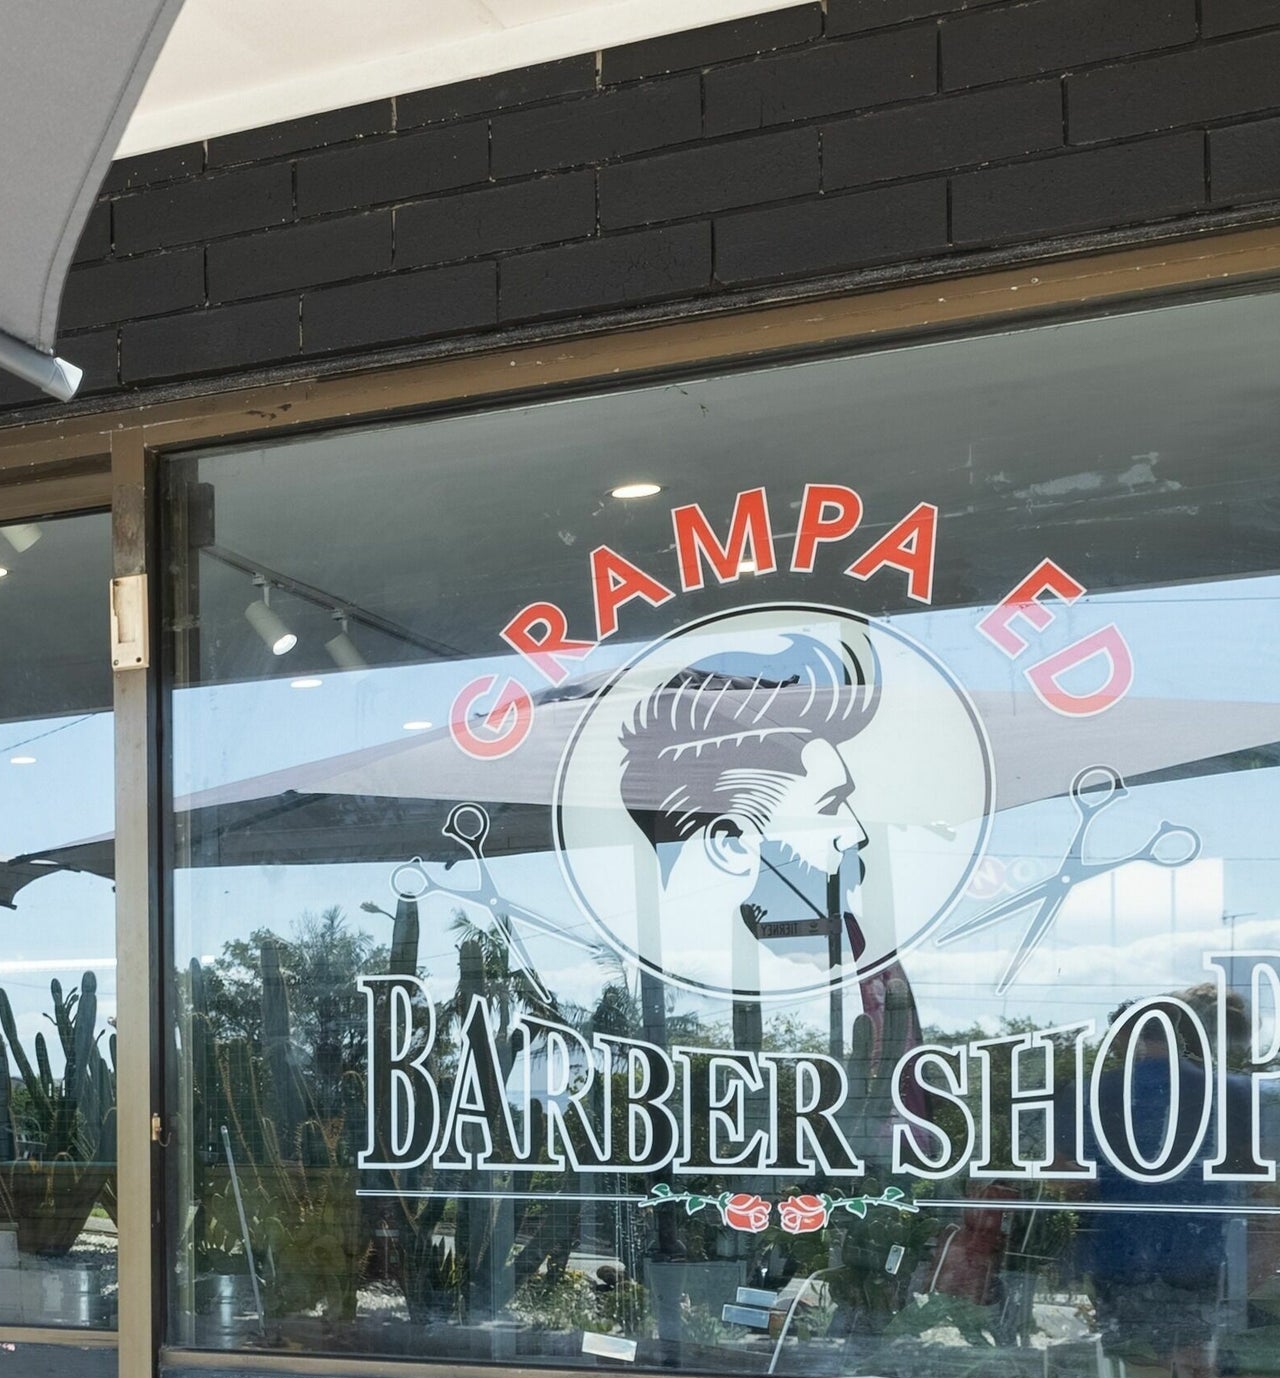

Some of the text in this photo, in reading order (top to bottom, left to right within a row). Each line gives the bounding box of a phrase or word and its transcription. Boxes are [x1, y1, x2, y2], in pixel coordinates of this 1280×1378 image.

[449, 483, 1135, 760] GRAMPA ED
[355, 950, 1280, 1183] BARBER SHOP
